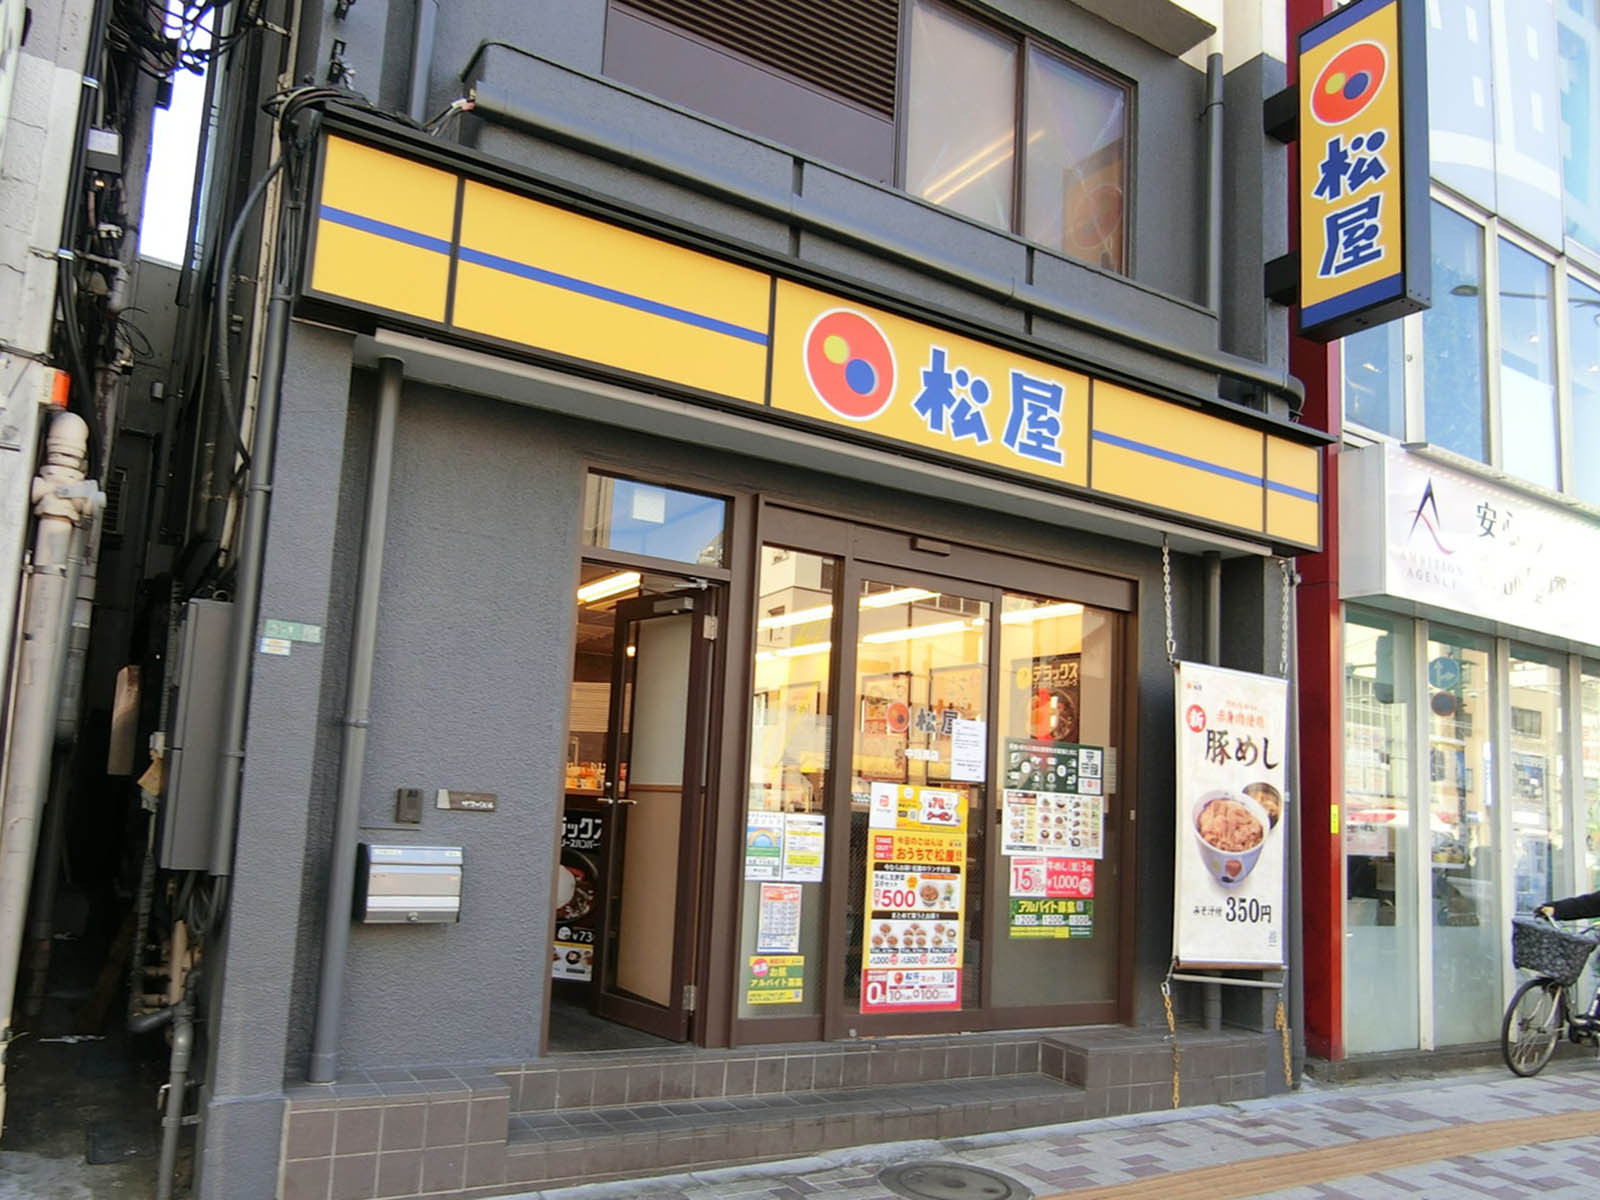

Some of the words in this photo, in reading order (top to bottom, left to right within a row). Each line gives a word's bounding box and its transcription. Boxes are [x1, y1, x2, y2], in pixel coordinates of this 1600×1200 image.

[1313, 129, 1388, 278] 松屋
[911, 344, 1065, 466] 松屋
[1033, 663, 1078, 682] デラックス
[915, 707, 958, 736] 松屋
[1205, 729, 1279, 769] 豚めし
[881, 889, 916, 908] 500
[1225, 897, 1272, 923] 350円
